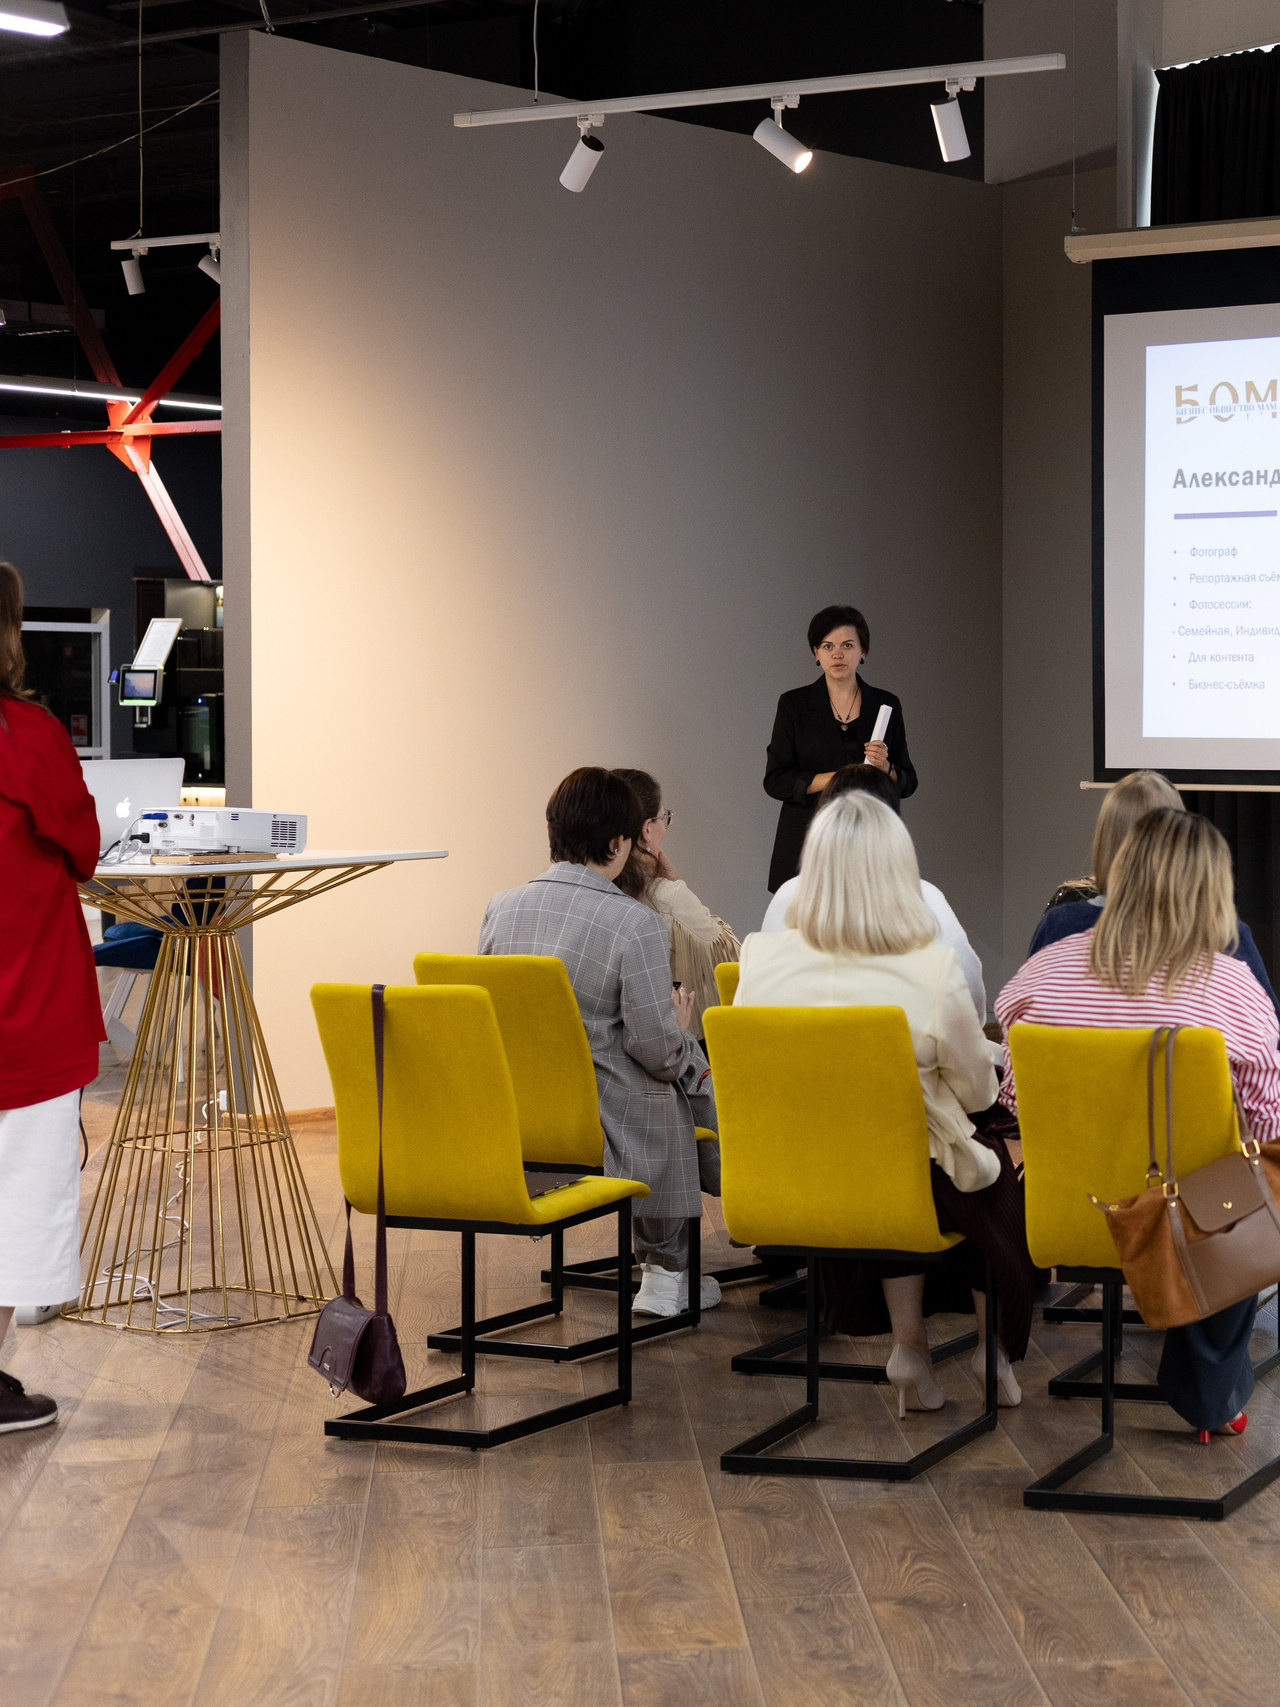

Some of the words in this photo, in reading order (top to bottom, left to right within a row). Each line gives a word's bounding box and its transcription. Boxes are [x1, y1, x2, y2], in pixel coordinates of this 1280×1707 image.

[1175, 379, 1278, 425] БОМ
[1175, 406, 1208, 416] БИЗНЕС
[1209, 403, 1255, 415] ОБЩЕСТВО
[1256, 402, 1278, 413] МАМ
[1189, 546, 1238, 559] Фотограф
[1189, 572, 1256, 585] Репортажная
[1189, 599, 1252, 610] Фотосессии:
[1188, 652, 1207, 664] Для
[1209, 652, 1255, 663] контента
[1188, 679, 1266, 691] Бизнес-съёмка
